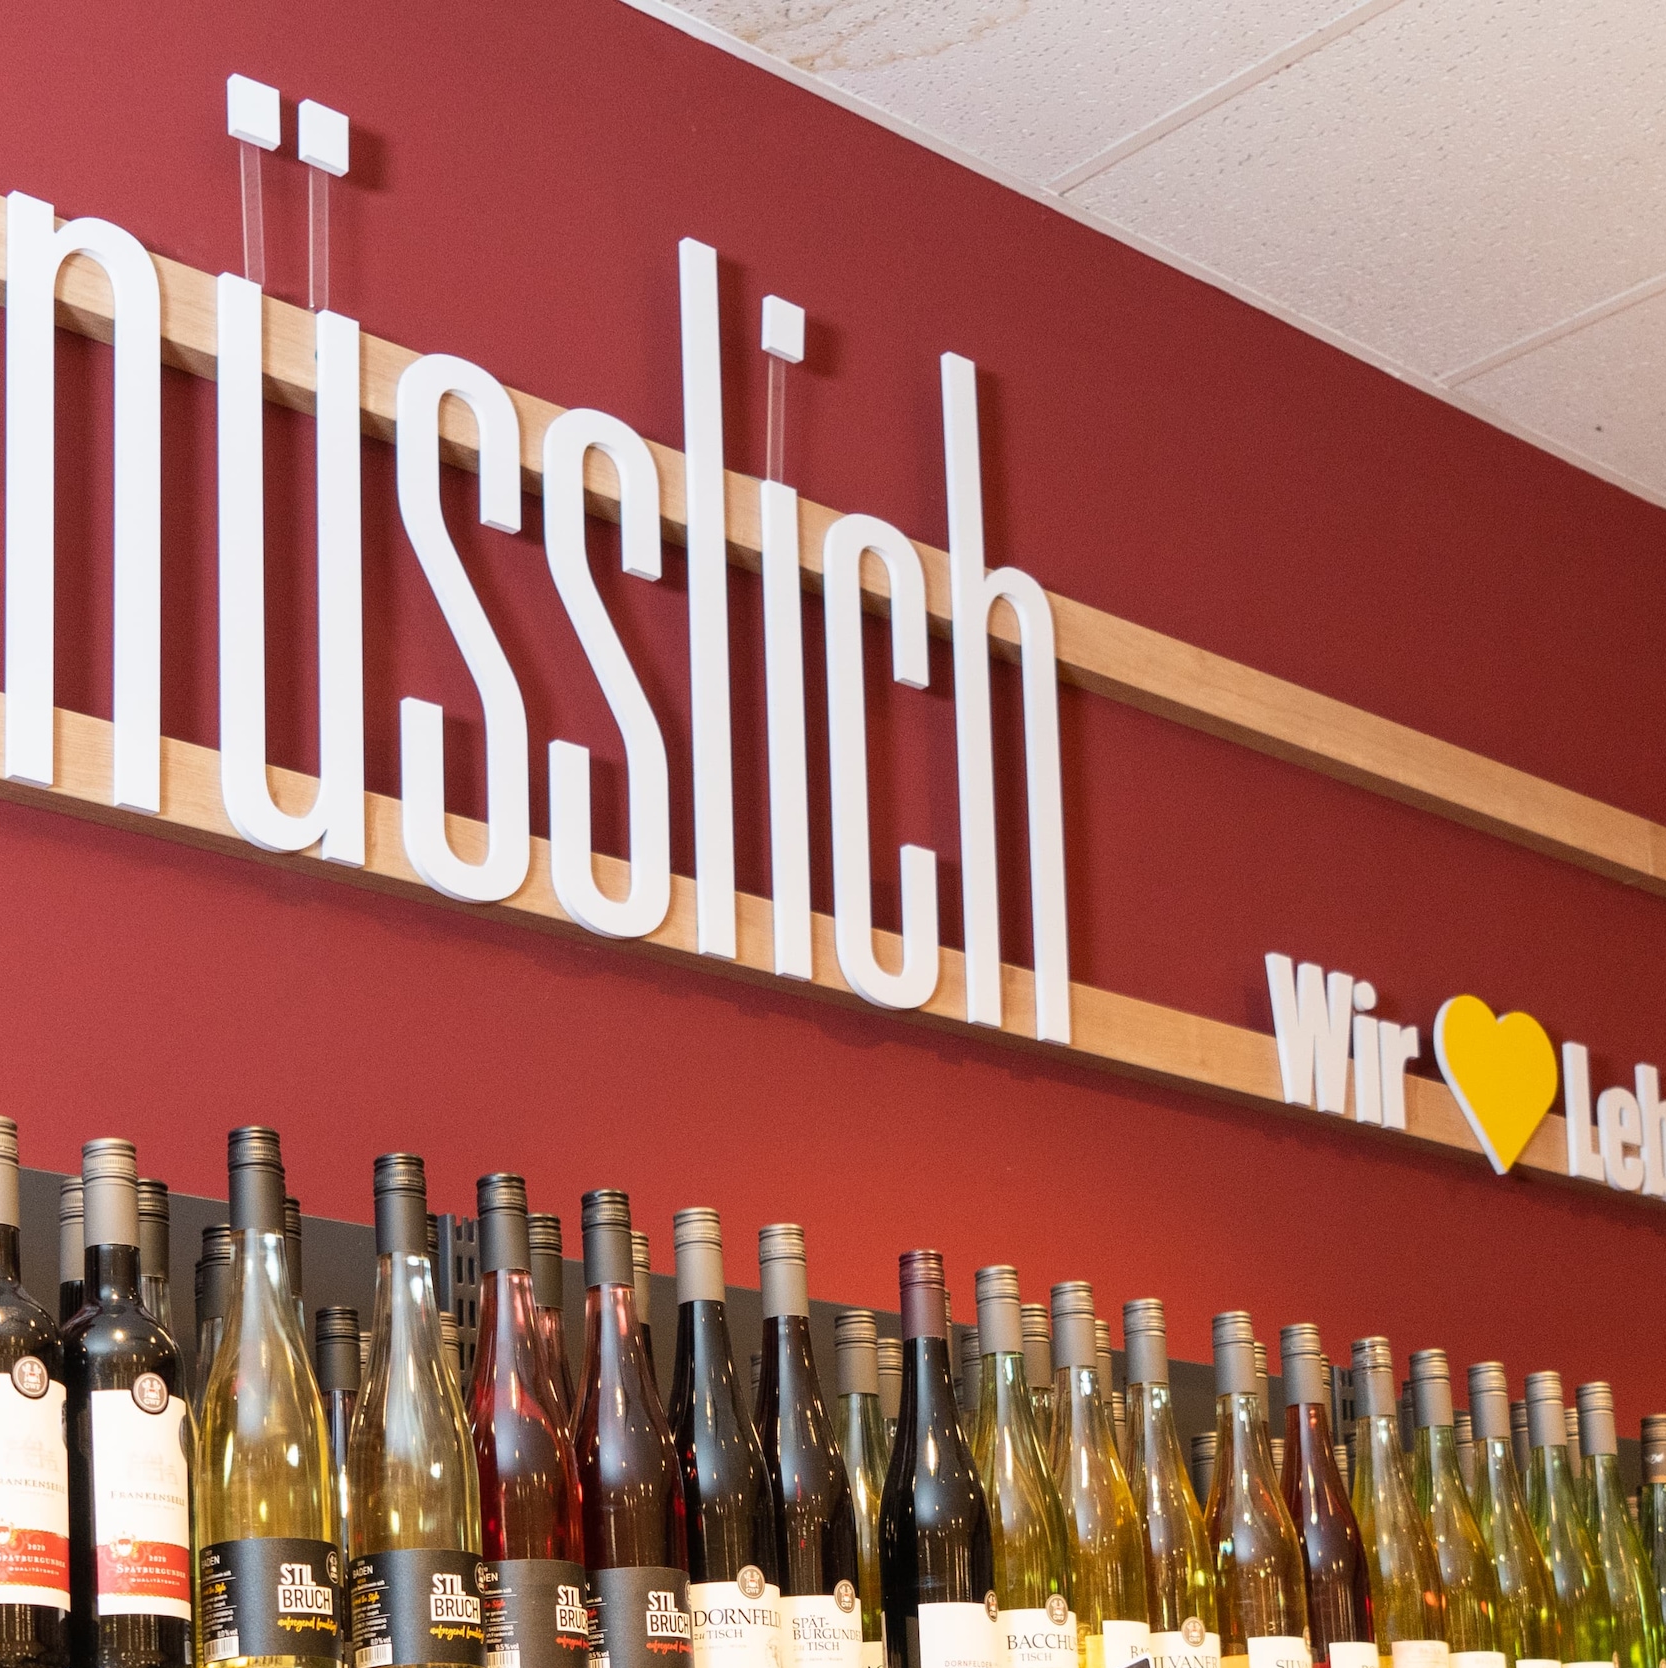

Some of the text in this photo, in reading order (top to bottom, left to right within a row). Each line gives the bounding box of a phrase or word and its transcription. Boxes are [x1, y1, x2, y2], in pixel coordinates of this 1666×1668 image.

[1265, 951, 1420, 1129] Wir
[110, 1490, 185, 1507] FRANKENSEELE
[280, 1563, 316, 1586] STIL
[433, 1574, 465, 1595] STIL
[283, 1589, 330, 1609] BRUCH
[558, 1585, 582, 1607] STIL
[648, 1591, 679, 1613] STIL
[435, 1596, 480, 1620] BRUCH
[650, 1614, 690, 1634] BRUCH
[707, 1628, 743, 1639] TISCH
[792, 1617, 829, 1631] SPÄT-
